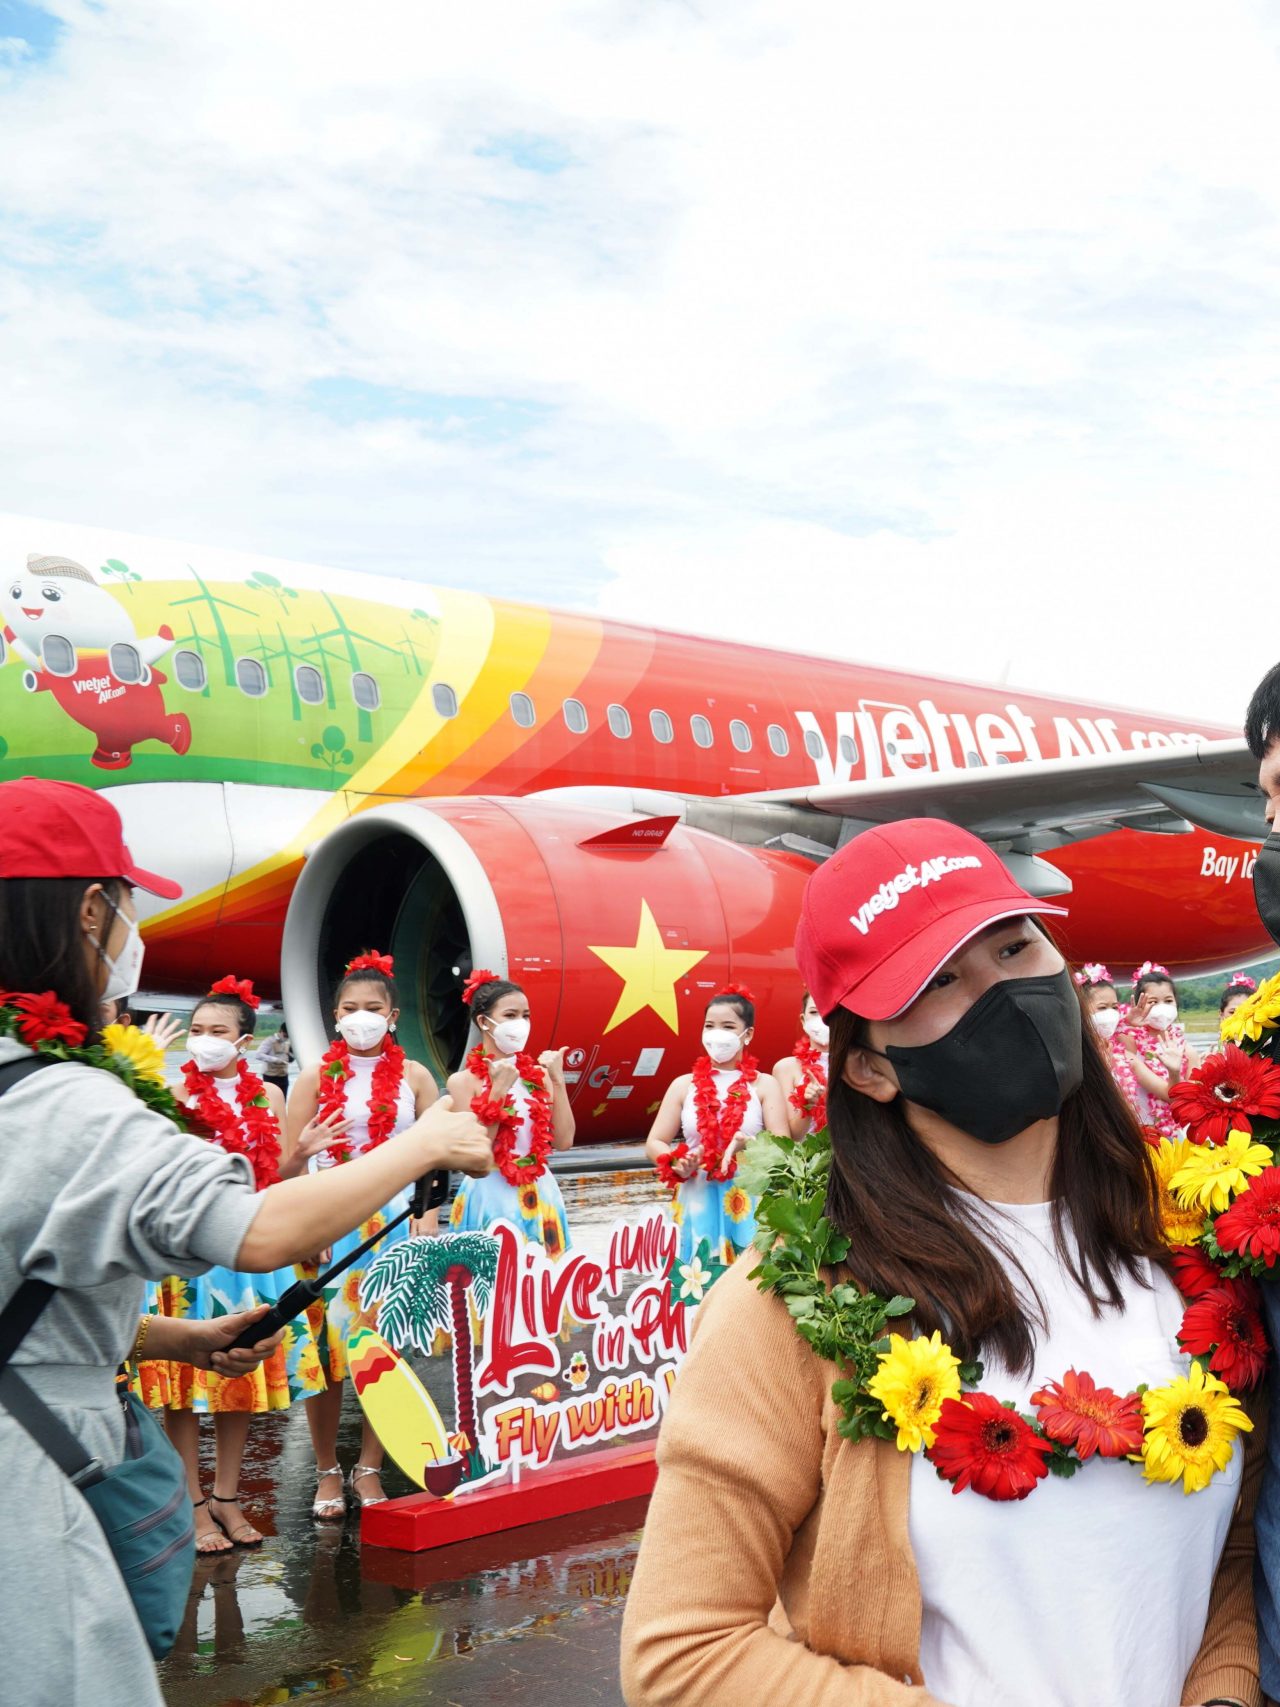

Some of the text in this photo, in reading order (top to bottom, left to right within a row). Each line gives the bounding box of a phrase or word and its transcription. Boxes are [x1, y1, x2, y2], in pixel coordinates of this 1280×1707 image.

[1053, 717, 1209, 757] Airc
[1200, 847, 1239, 884] Bay
[479, 1214, 676, 1389] Live fully
[597, 1280, 687, 1366] in Ph
[495, 1378, 654, 1464] Fly with
